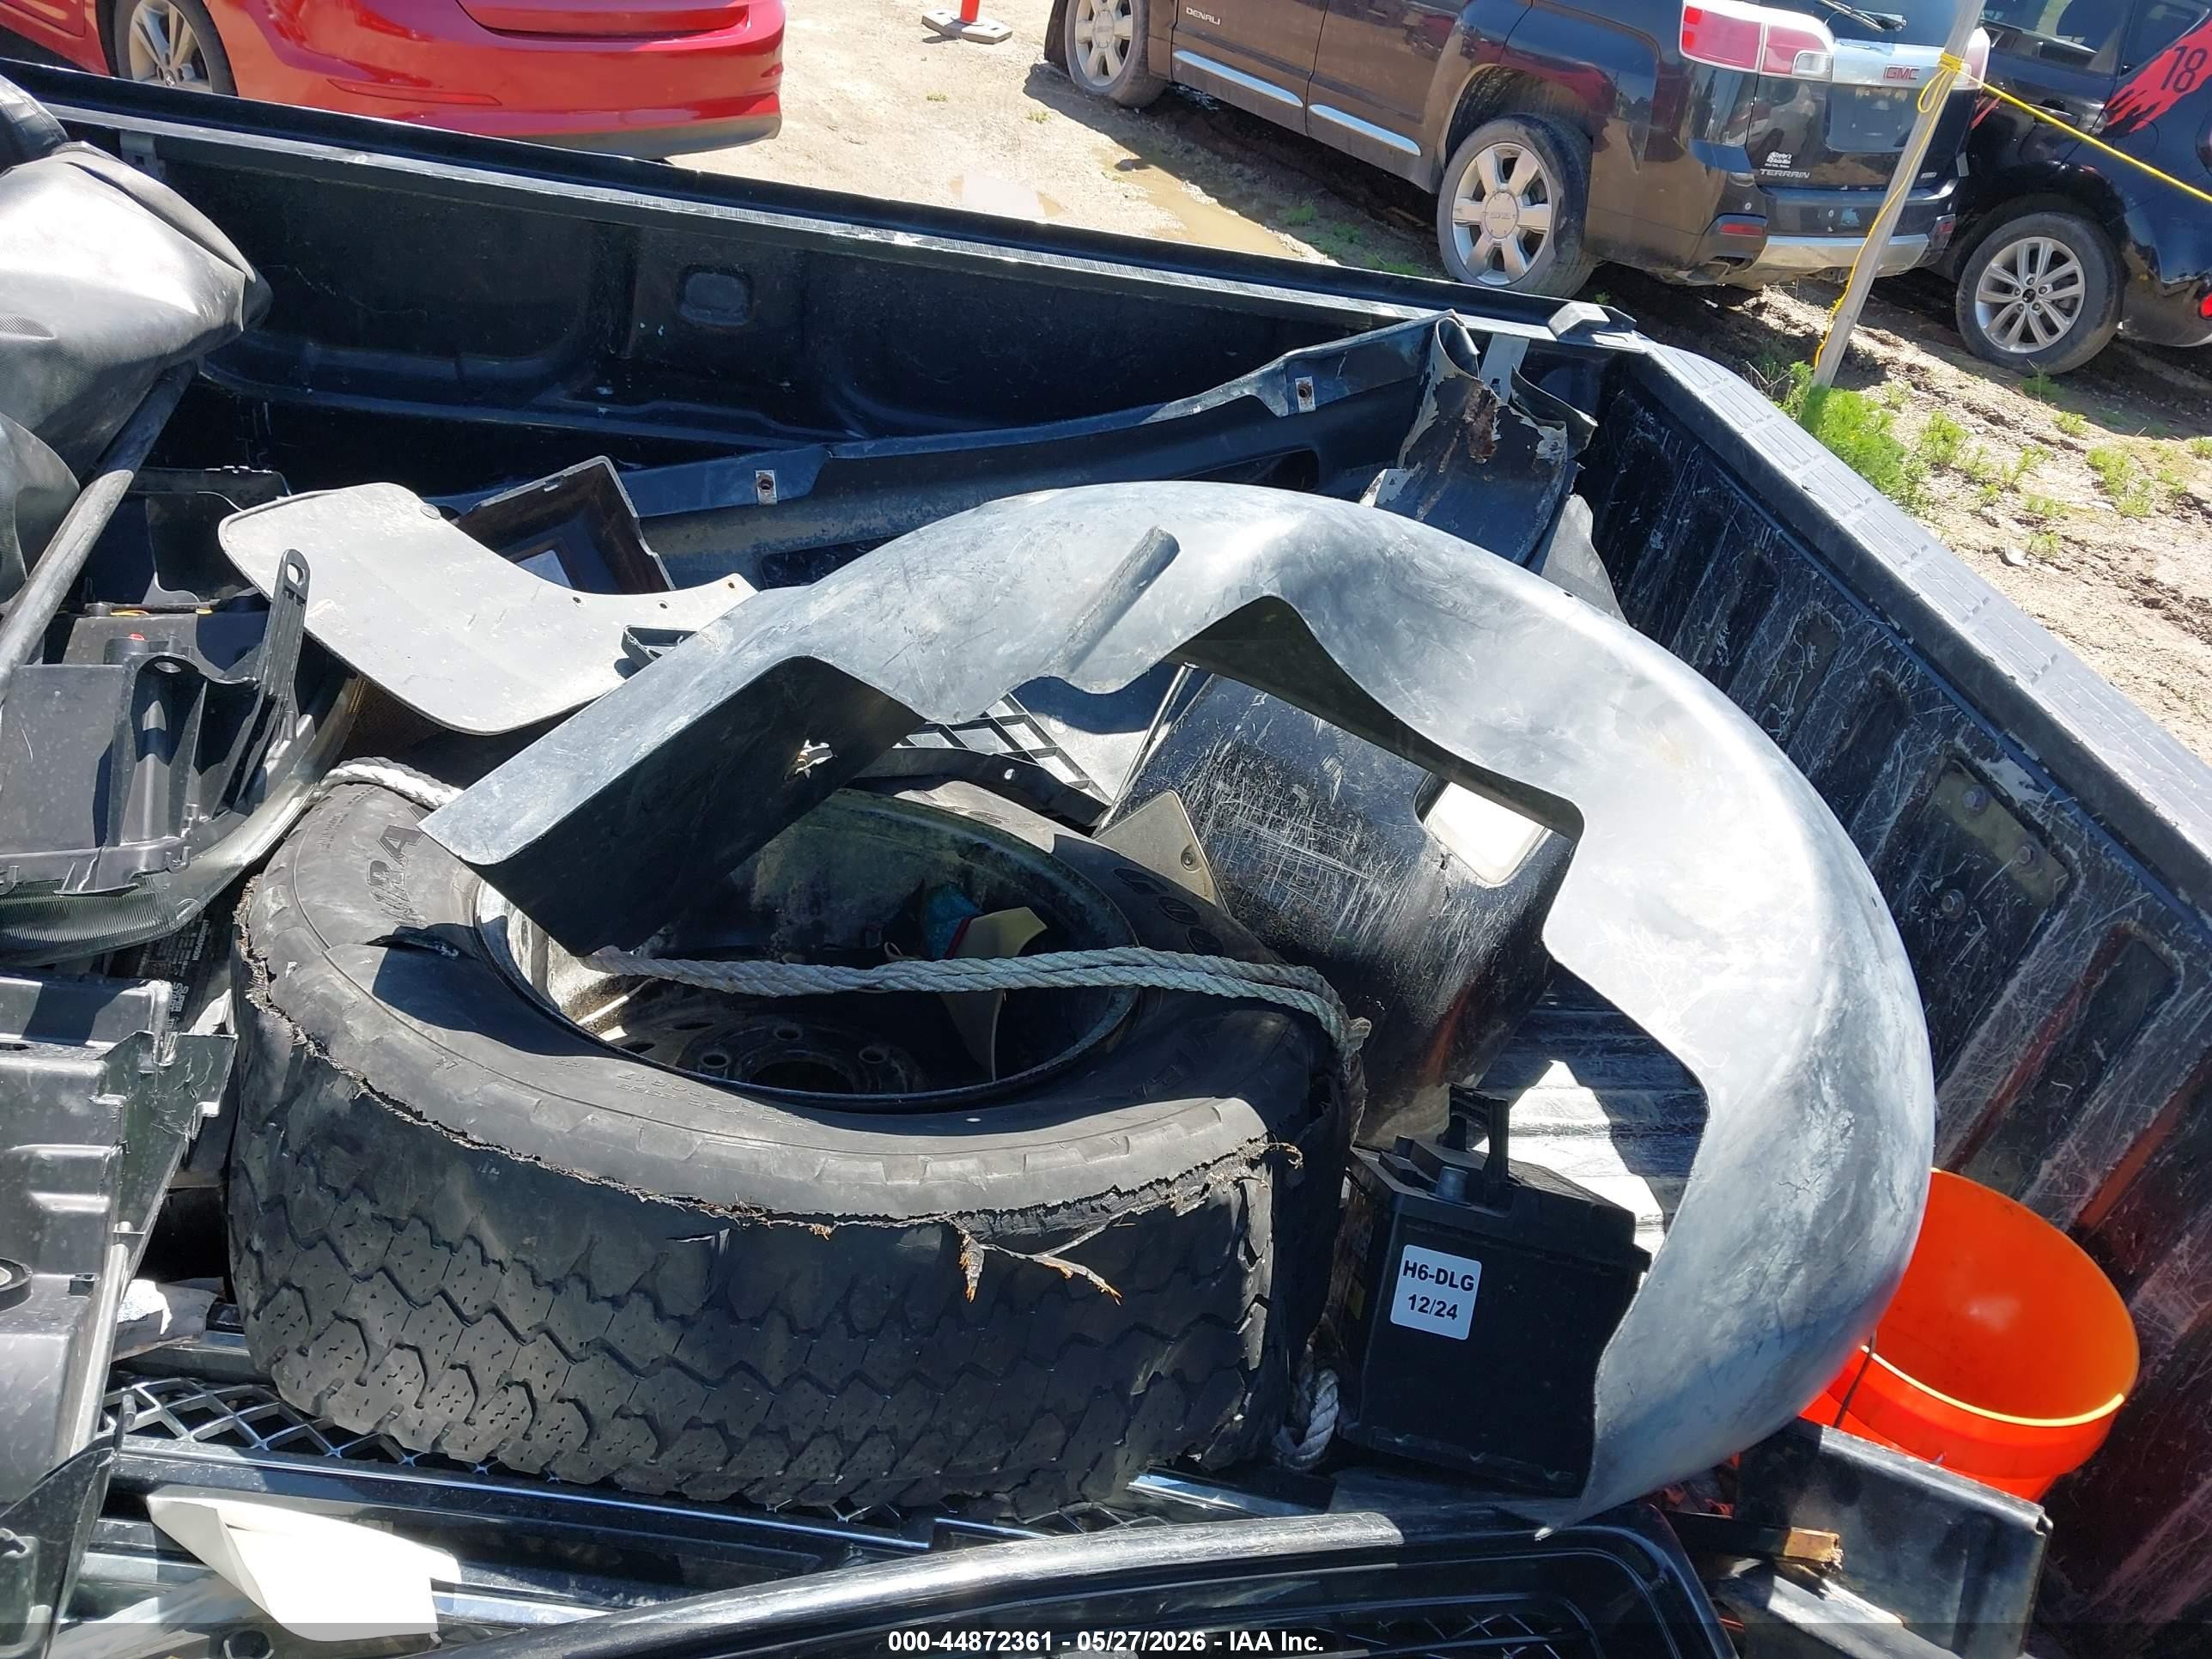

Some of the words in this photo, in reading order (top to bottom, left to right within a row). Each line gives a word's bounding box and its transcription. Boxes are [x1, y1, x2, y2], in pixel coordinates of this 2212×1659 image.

[1186, 7, 1220, 25] DENALI
[1885, 64, 1919, 80] GMC
[2160, 46, 2208, 93] 18
[1759, 168, 1810, 179] TERRAIN
[174, 985, 190, 1012] SUPER
[1402, 1260, 1474, 1291] H6-DLG
[1408, 1294, 1458, 1321] 12/24
